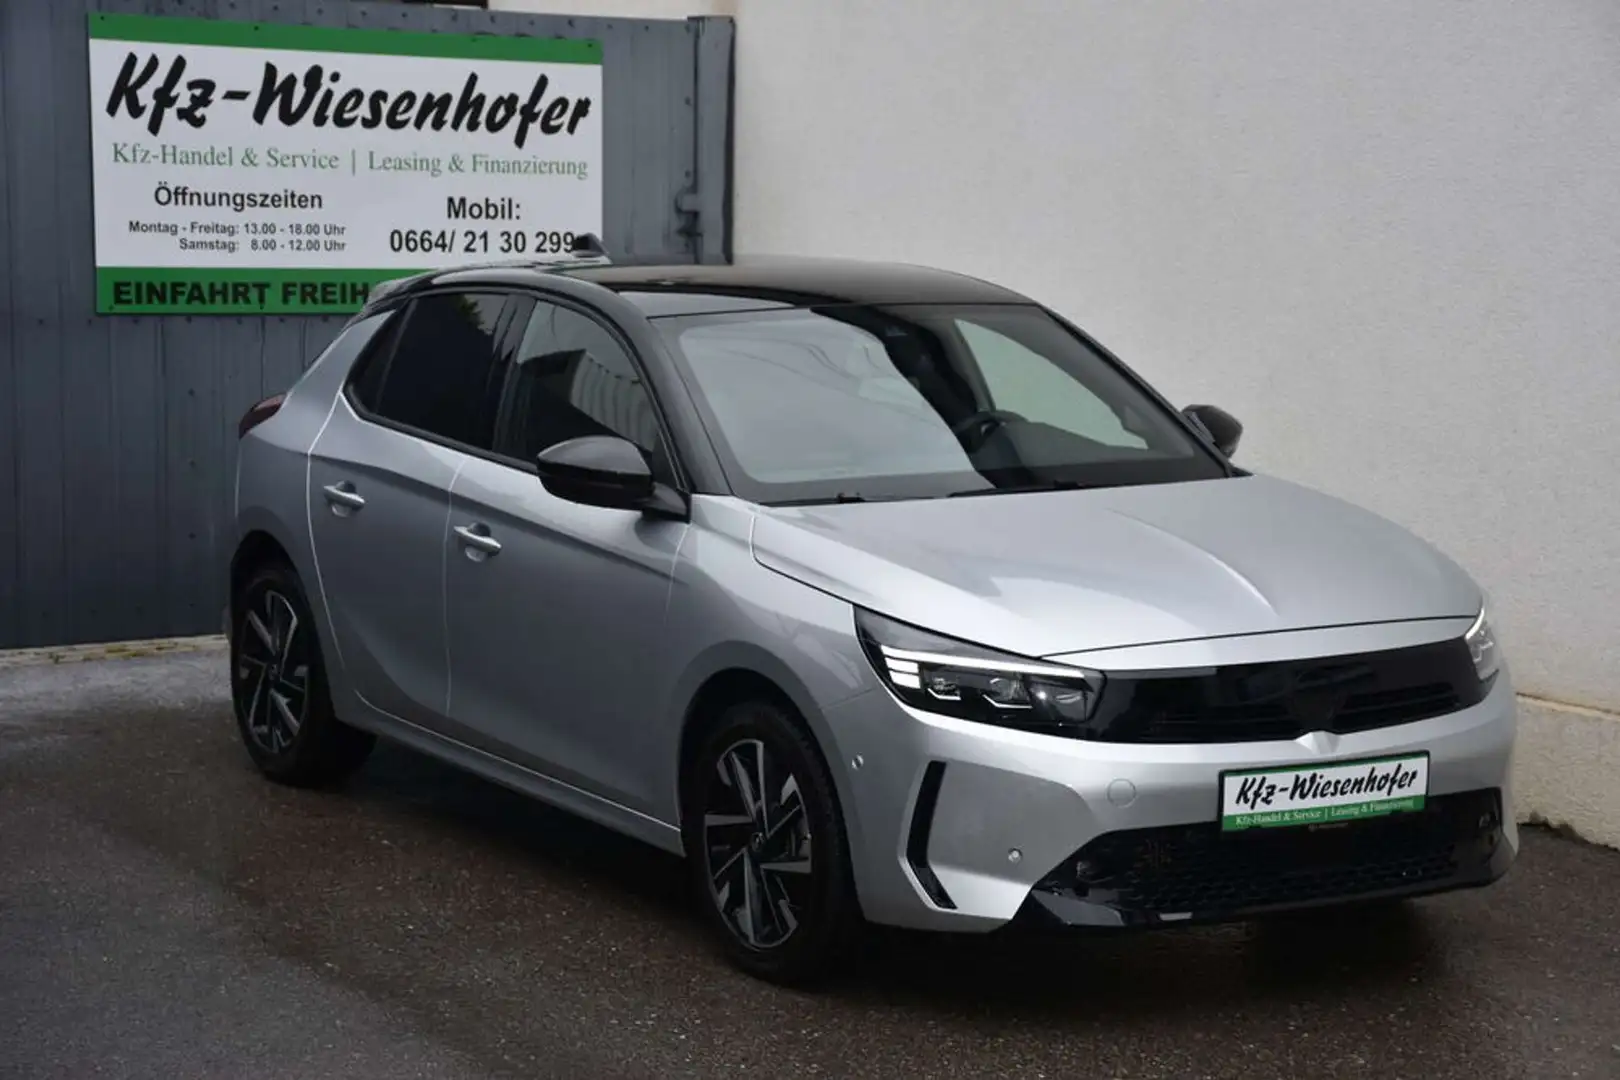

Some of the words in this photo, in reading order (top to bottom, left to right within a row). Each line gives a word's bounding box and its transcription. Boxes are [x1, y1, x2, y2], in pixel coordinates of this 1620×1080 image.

[106, 51, 592, 149] Kfz-Wiesenhofer
[112, 142, 233, 167] Kfz-Handel
[240, 147, 259, 167] &
[266, 147, 340, 169] Service
[368, 150, 442, 177] Leasing
[448, 153, 465, 173] &
[472, 153, 588, 180] Finanzierung
[154, 181, 324, 212] Öffnungszeiten
[447, 196, 521, 220] Mobil:
[129, 220, 178, 236] Montag
[190, 221, 240, 236] Freitag:
[244, 222, 276, 234] 13.00
[289, 223, 320, 235] 18.00
[324, 223, 346, 235] Uhr
[179, 238, 240, 253] Samstag:
[251, 239, 276, 250] 8.00
[289, 240, 320, 251] 12.00
[324, 239, 346, 251] Uhr
[389, 229, 455, 253] 0664/
[464, 230, 488, 253] 21
[500, 231, 526, 253] 30
[113, 281, 270, 305] EINFAHRT
[1235, 763, 1418, 810] Kfz-Wiesenhofer
